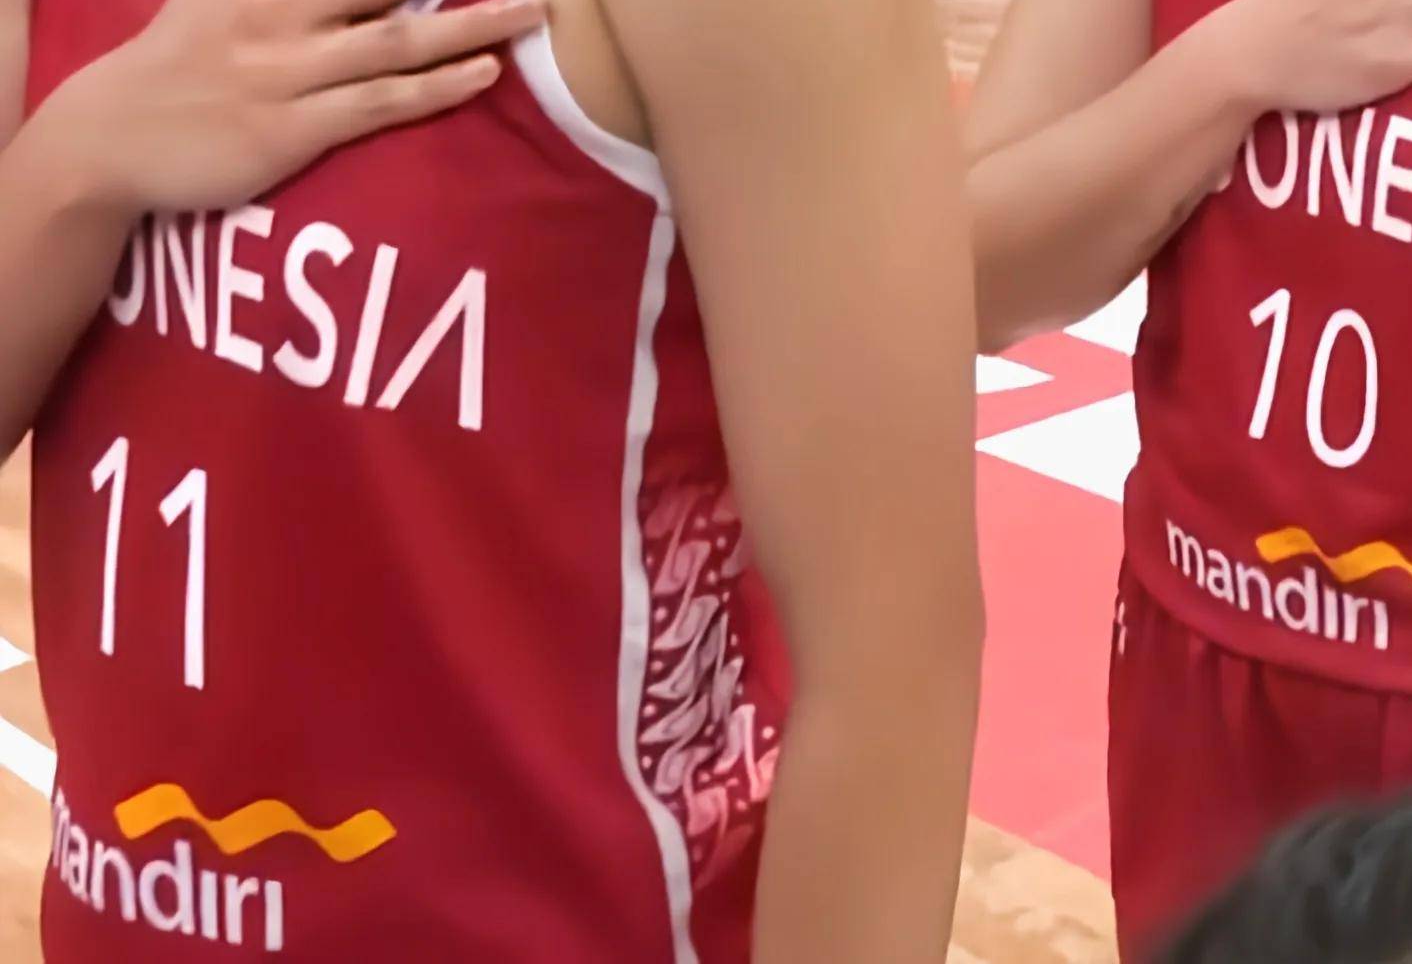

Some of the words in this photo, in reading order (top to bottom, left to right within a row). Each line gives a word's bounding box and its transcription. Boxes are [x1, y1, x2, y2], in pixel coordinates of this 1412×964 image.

[1248, 287, 1379, 469] 10
[90, 435, 208, 691] 11
[1165, 518, 1390, 651] mandiri
